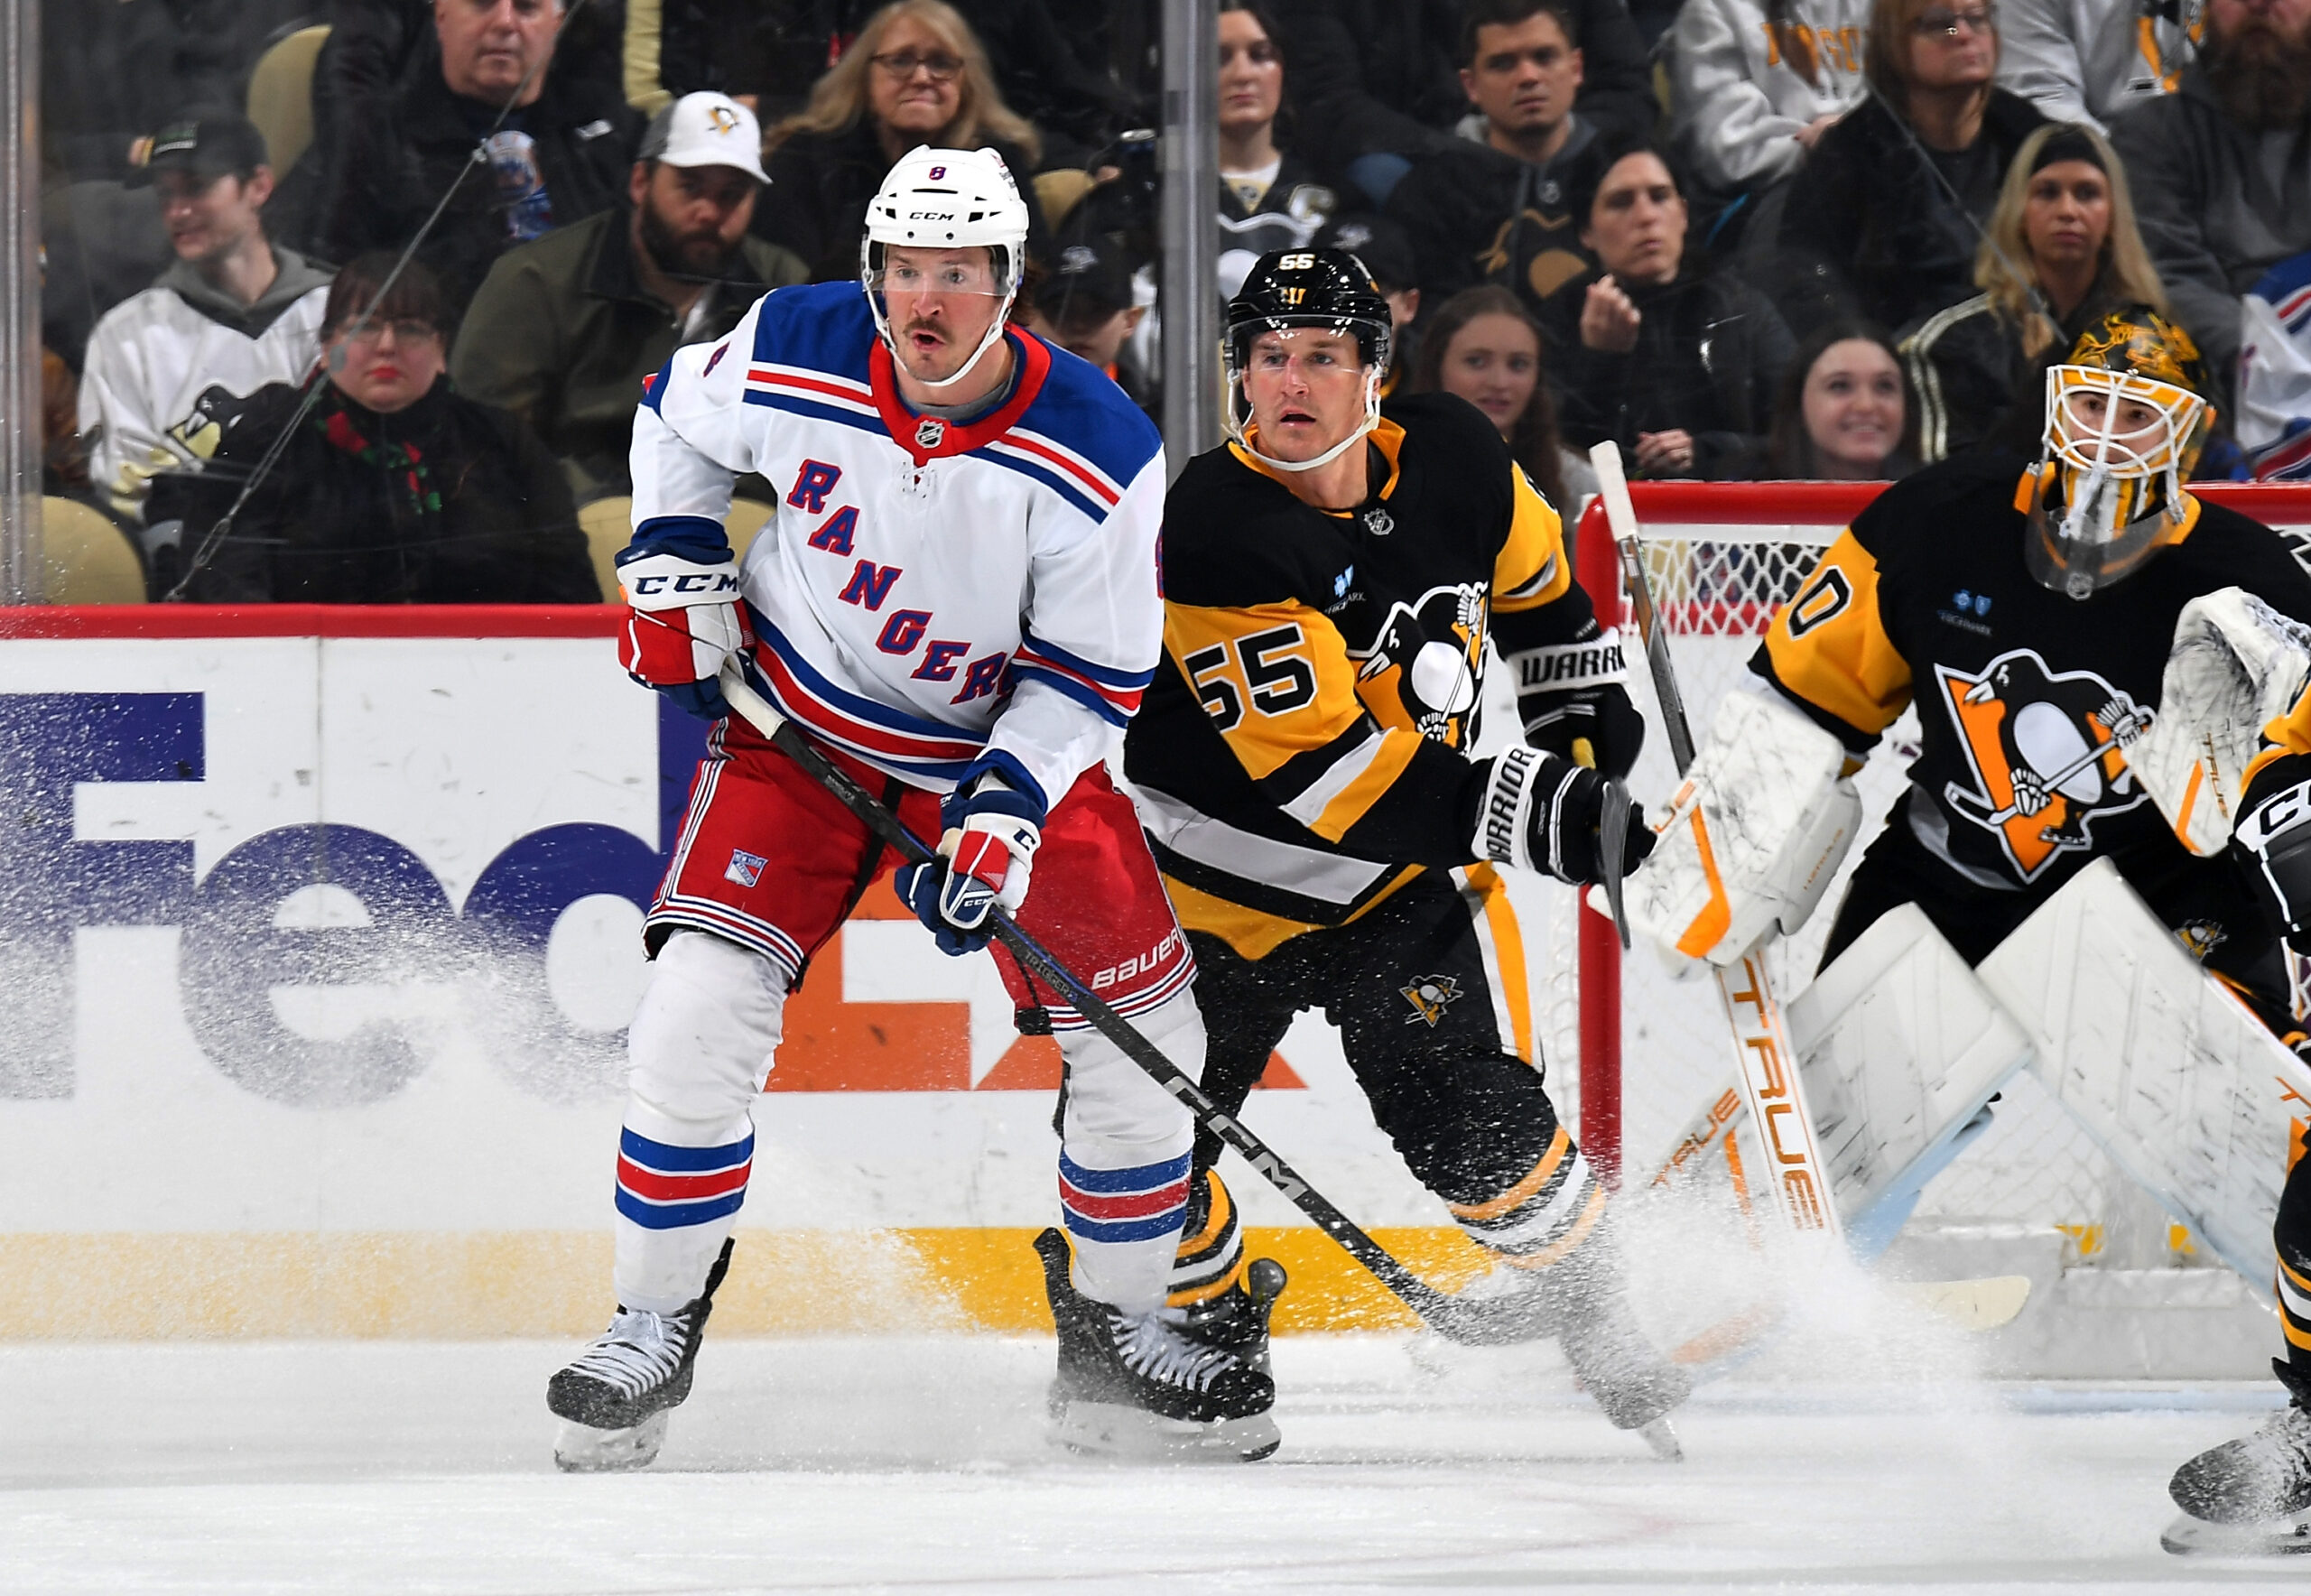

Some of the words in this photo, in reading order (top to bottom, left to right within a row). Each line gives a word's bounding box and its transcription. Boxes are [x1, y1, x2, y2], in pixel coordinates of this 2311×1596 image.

[929, 166, 947, 181] 8
[909, 211, 955, 221] CCM
[1278, 254, 1315, 270] 55
[635, 573, 738, 595] CCM
[1182, 621, 1319, 736] 55
[1653, 779, 1697, 834] UE
[2259, 786, 2311, 836] C
[1091, 928, 1182, 990] BAUER
[1732, 956, 1824, 1229] TRUE
[1163, 1075, 1309, 1202] CCM
